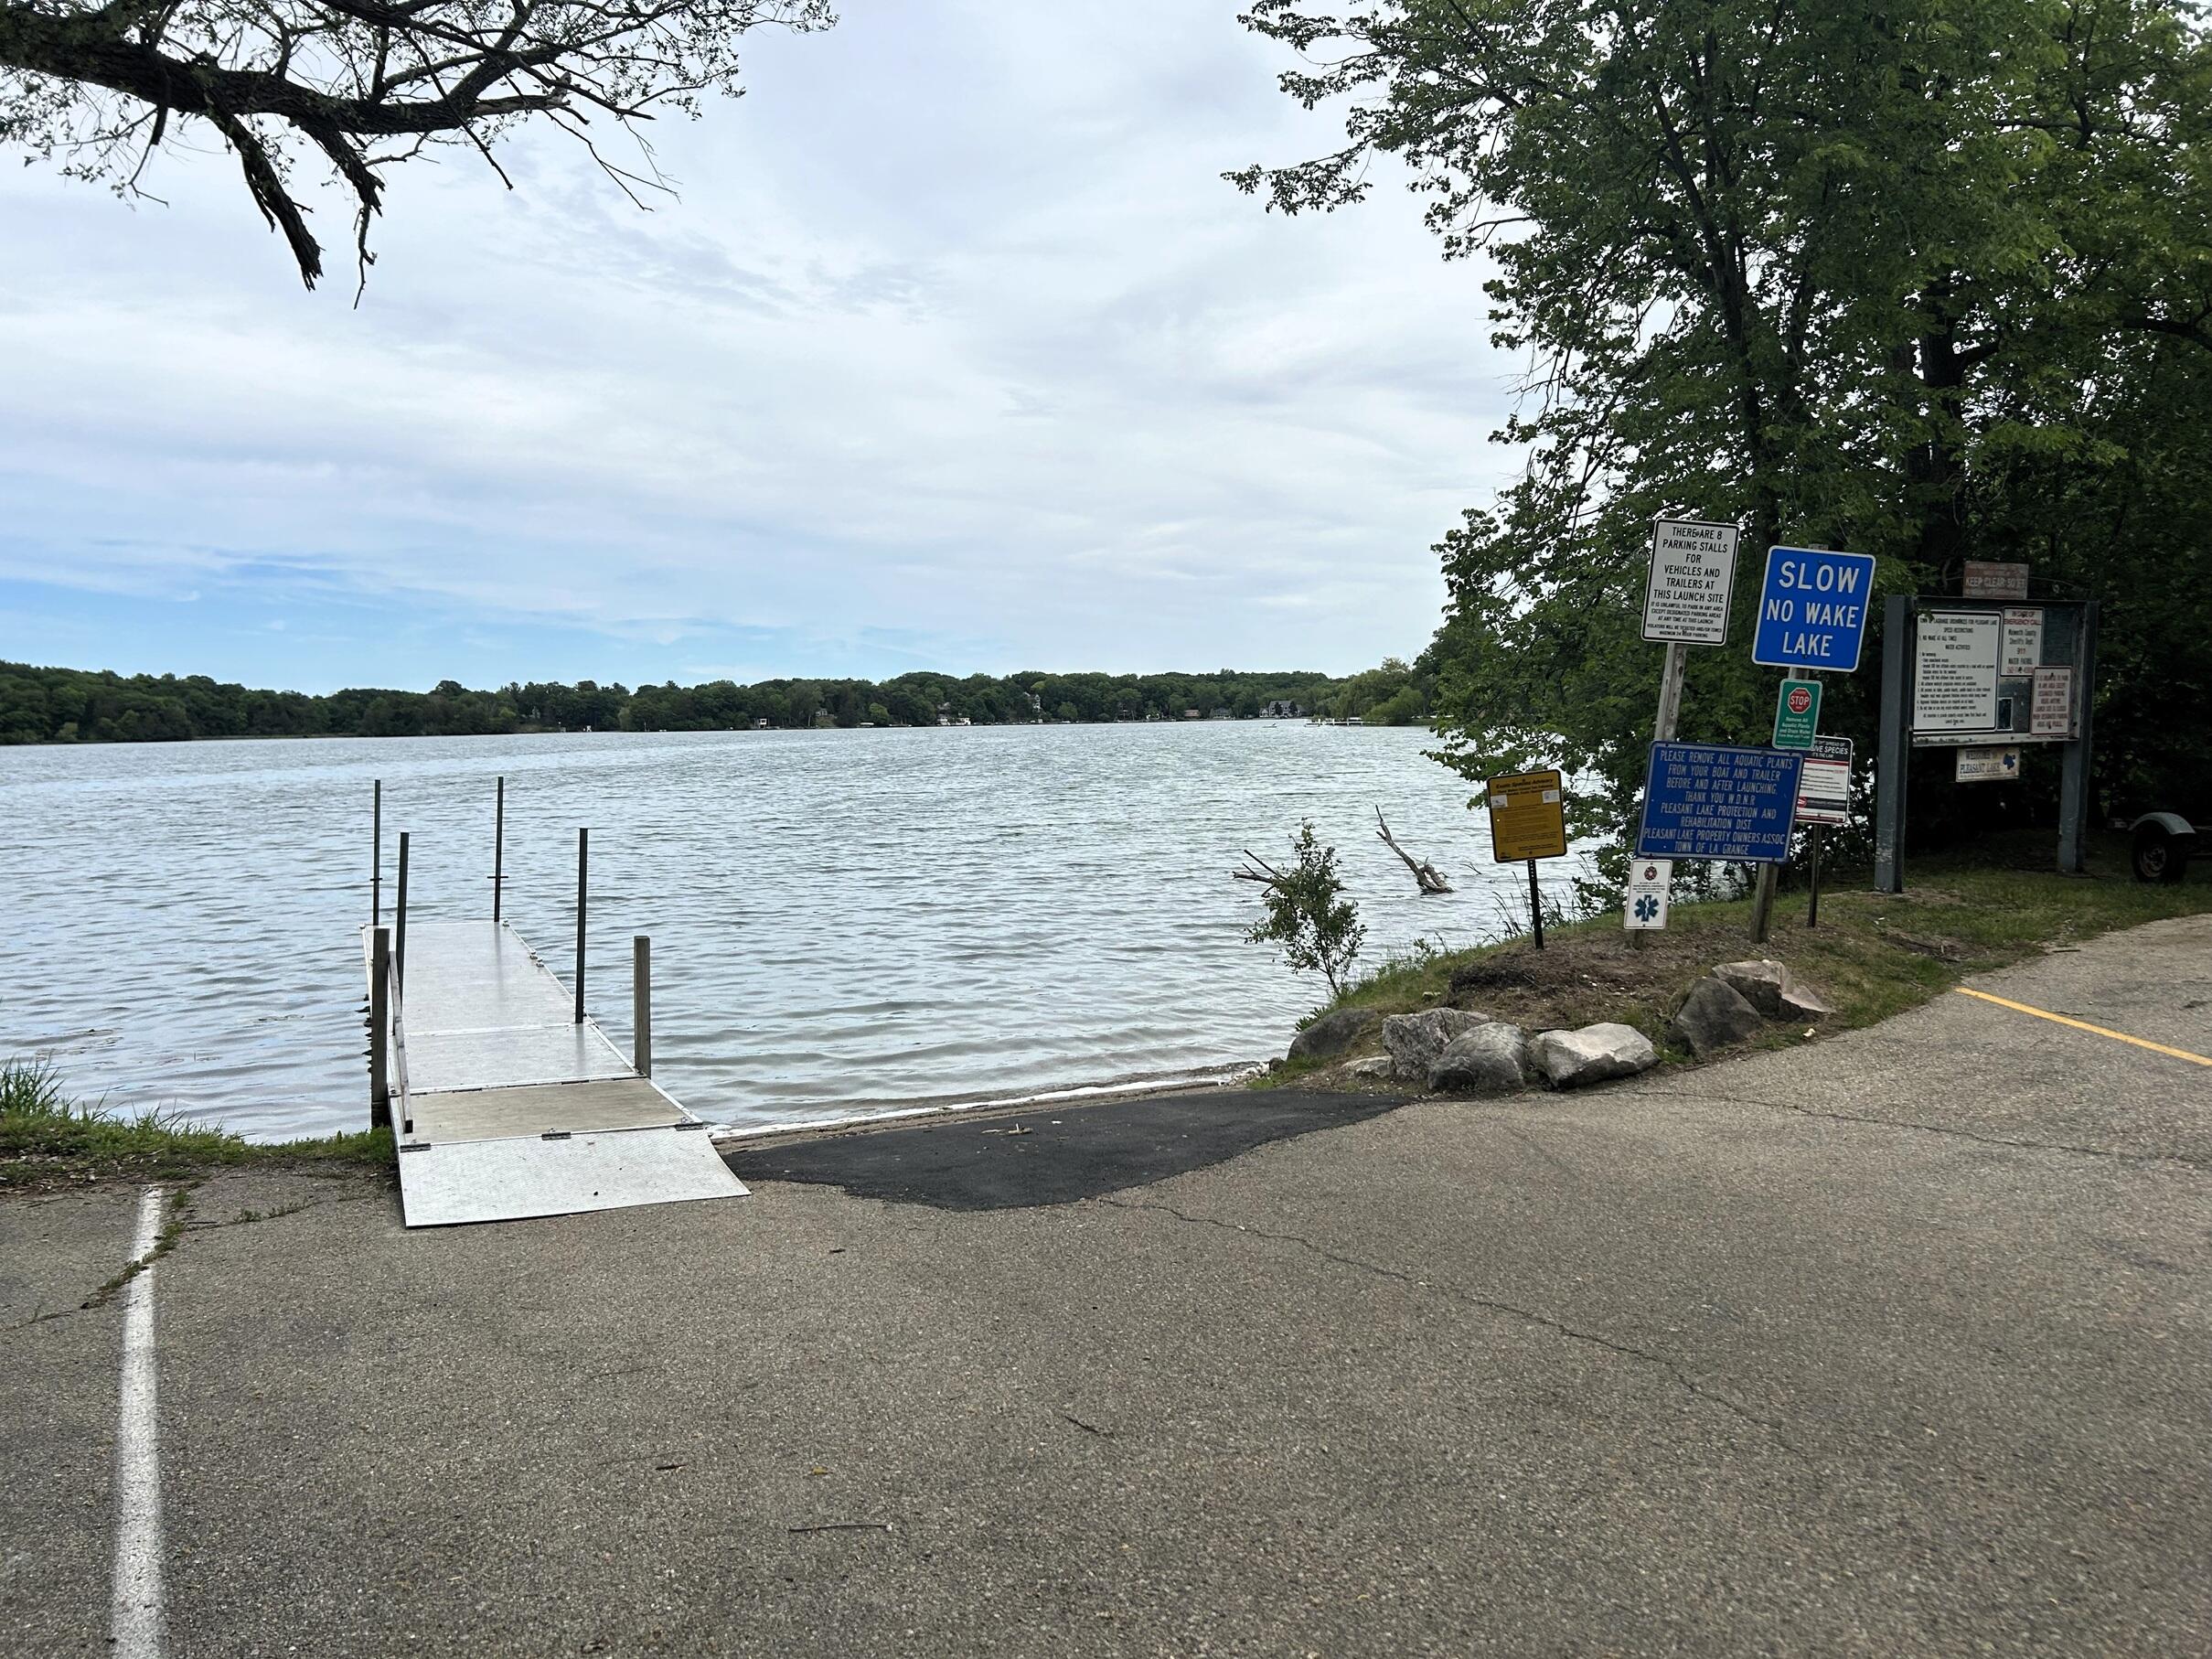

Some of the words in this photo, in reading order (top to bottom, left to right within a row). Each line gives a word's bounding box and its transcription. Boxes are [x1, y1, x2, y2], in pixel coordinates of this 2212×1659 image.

[1672, 527, 1696, 537] THERE
[1699, 530, 1715, 539] ARE
[1716, 530, 1722, 540] 8
[1662, 539, 1697, 551] PARKING
[1700, 542, 1727, 552] STALLS
[1685, 553, 1701, 563] FOR
[1664, 564, 1701, 576] VEHICLES
[1704, 568, 1720, 577] AND
[1666, 577, 1703, 589] TRAILERS
[1704, 581, 1715, 590] AT
[1779, 561, 1860, 594] SLOW
[1966, 577, 1982, 586] KEEP
[1984, 577, 2004, 587] CLEAR
[1653, 589, 1671, 599] THIS
[1673, 590, 1704, 602] LAUNCH
[1707, 594, 1724, 603] SITE
[1767, 598, 1794, 622] NO
[1806, 602, 1859, 628] WAKE
[1782, 631, 1833, 657] LAKE
[1790, 696, 1809, 705] STOP
[1824, 746, 1848, 755] SPECIES
[1660, 750, 1685, 762] PLEASE
[1689, 752, 1714, 764] REMOVE
[1717, 754, 1730, 765] ALL
[1734, 755, 1763, 768] AQUATIC
[1767, 756, 1793, 770] PLANTS
[1668, 764, 1687, 776] FROM
[1691, 765, 1708, 776] YOUR
[1712, 766, 1729, 777] BOAT
[1733, 767, 1747, 778] AND
[1752, 769, 1780, 781] TRAILER
[1666, 777, 1691, 789] BEFORE
[1694, 779, 1708, 789] AND
[1712, 779, 1733, 791] AFTER
[1684, 791, 1705, 803] THANK
[1711, 792, 1725, 803] YOU
[1661, 802, 1694, 815] PLEASANT
[1696, 805, 1714, 816] LAKE
[1717, 805, 1758, 818] PROTECTION
[1761, 808, 1777, 819] AND
[1680, 816, 1731, 829] REHABILITATION
[1644, 827, 1676, 840] PLEASANT
[1677, 829, 1694, 840] LAKE
[1696, 830, 1731, 842] PROPERTY
[1732, 831, 1760, 843] OWNERS
[1674, 840, 1692, 852] TOWN
[1695, 842, 1705, 853] OF
[1709, 843, 1718, 853] LA
[1722, 844, 1749, 855] GRANGE
